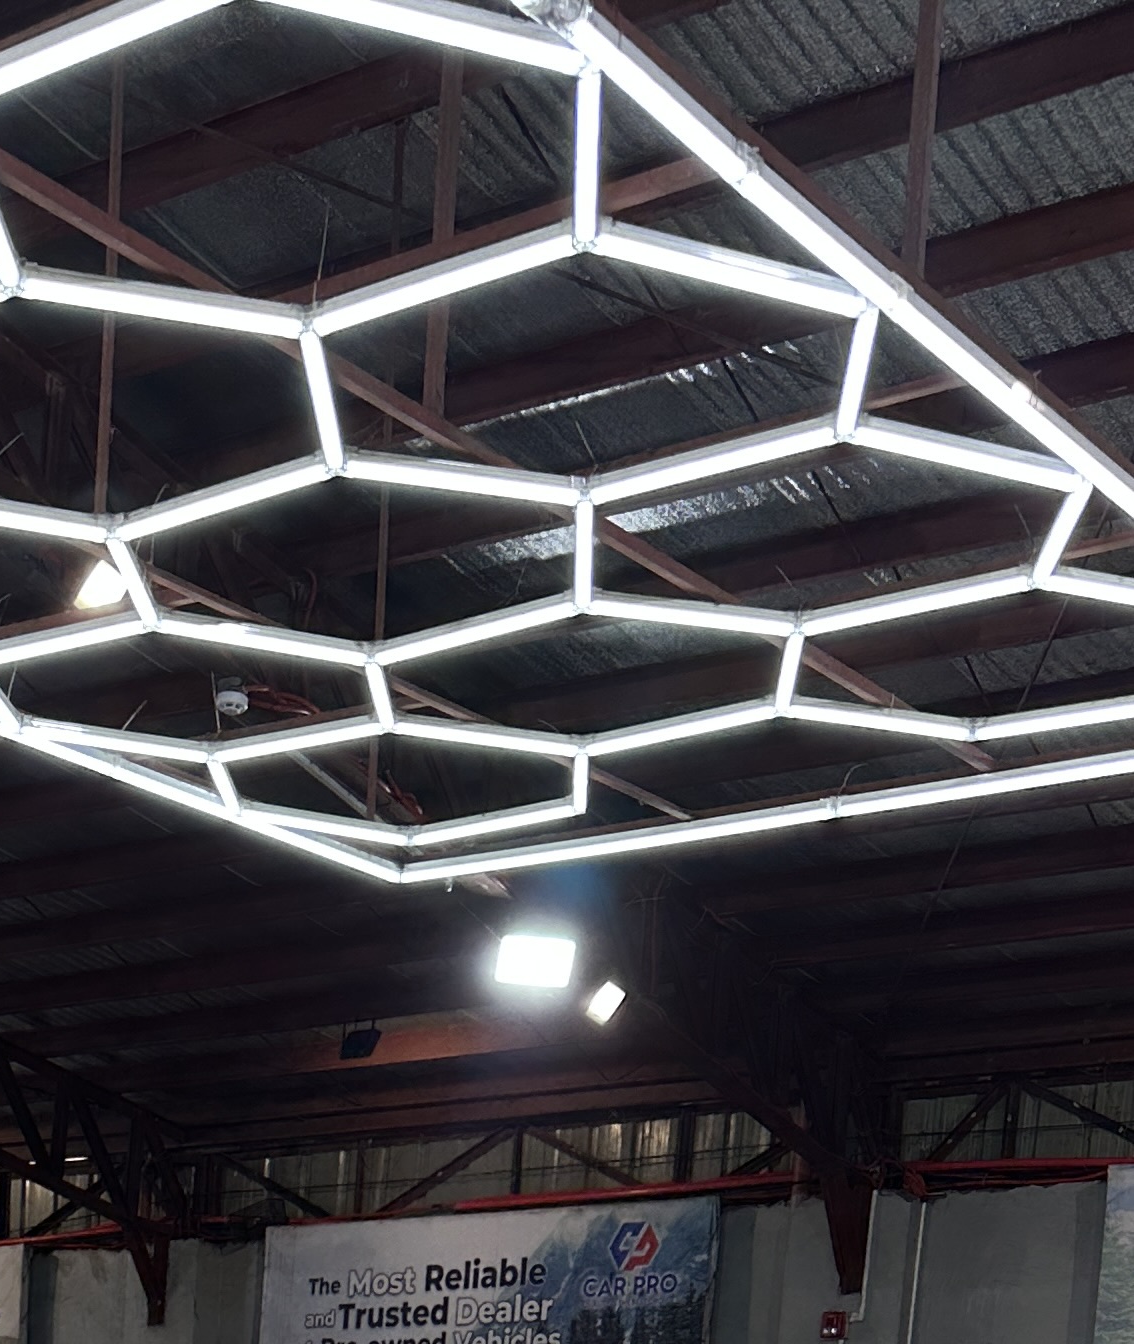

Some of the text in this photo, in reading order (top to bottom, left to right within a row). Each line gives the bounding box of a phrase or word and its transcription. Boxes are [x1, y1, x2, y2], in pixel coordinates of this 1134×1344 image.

[308, 1256, 547, 1298] The Most Reliable
[583, 1273, 678, 1297] CAR PRO
[304, 1294, 554, 1330] and Trusted Dealer
